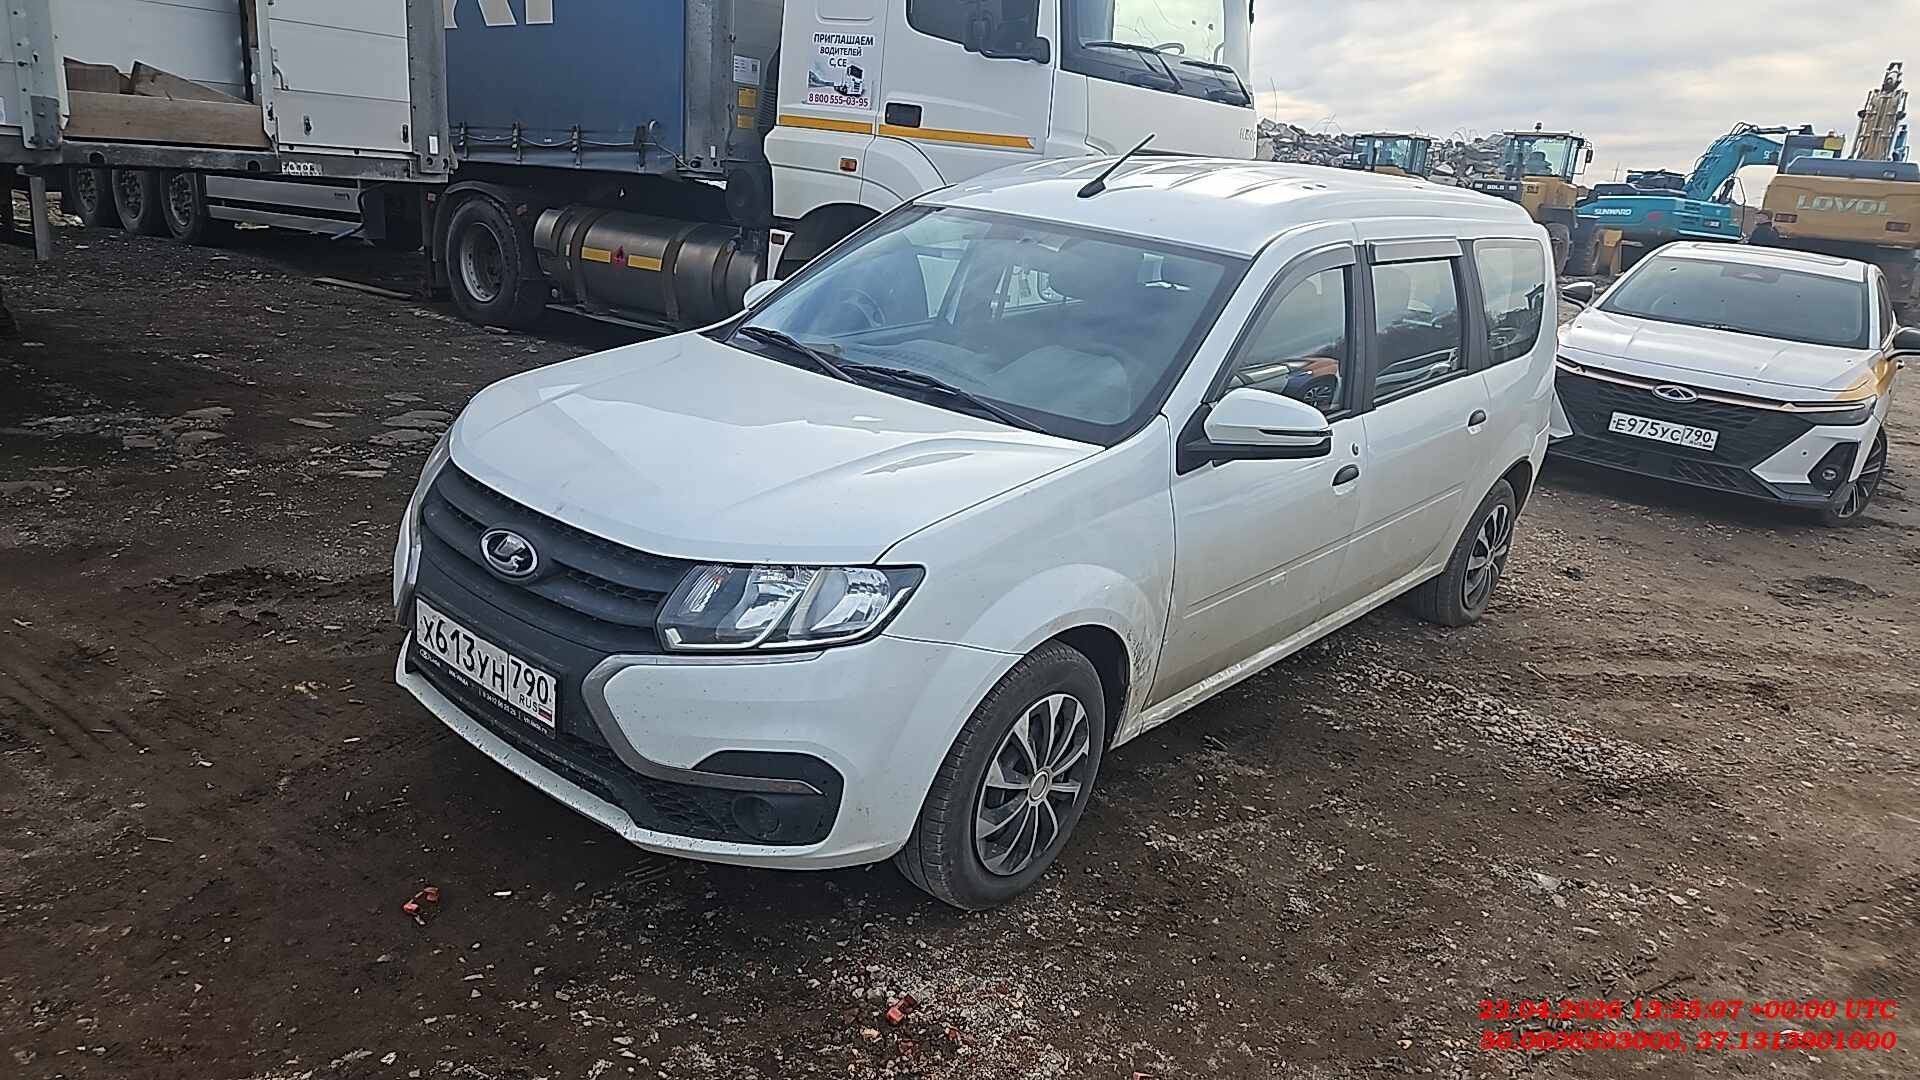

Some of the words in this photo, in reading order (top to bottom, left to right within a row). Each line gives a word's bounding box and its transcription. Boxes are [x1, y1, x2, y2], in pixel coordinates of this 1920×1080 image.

[813, 33, 874, 46] ПРИГЛАШАЕМ
[819, 46, 863, 57] ВОДИТЕЛЕЙ
[808, 93, 814, 102] 8
[814, 94, 829, 104] 800
[830, 95, 869, 107] 555-03-95
[1593, 208, 1633, 216] SUNWARD
[1796, 193, 1893, 216] LOVOL
[1615, 418, 1682, 441] Е975УС
[1685, 428, 1712, 443] 790
[422, 615, 505, 693] Х613УН
[510, 659, 549, 705] 790
[519, 694, 538, 713] RUS
